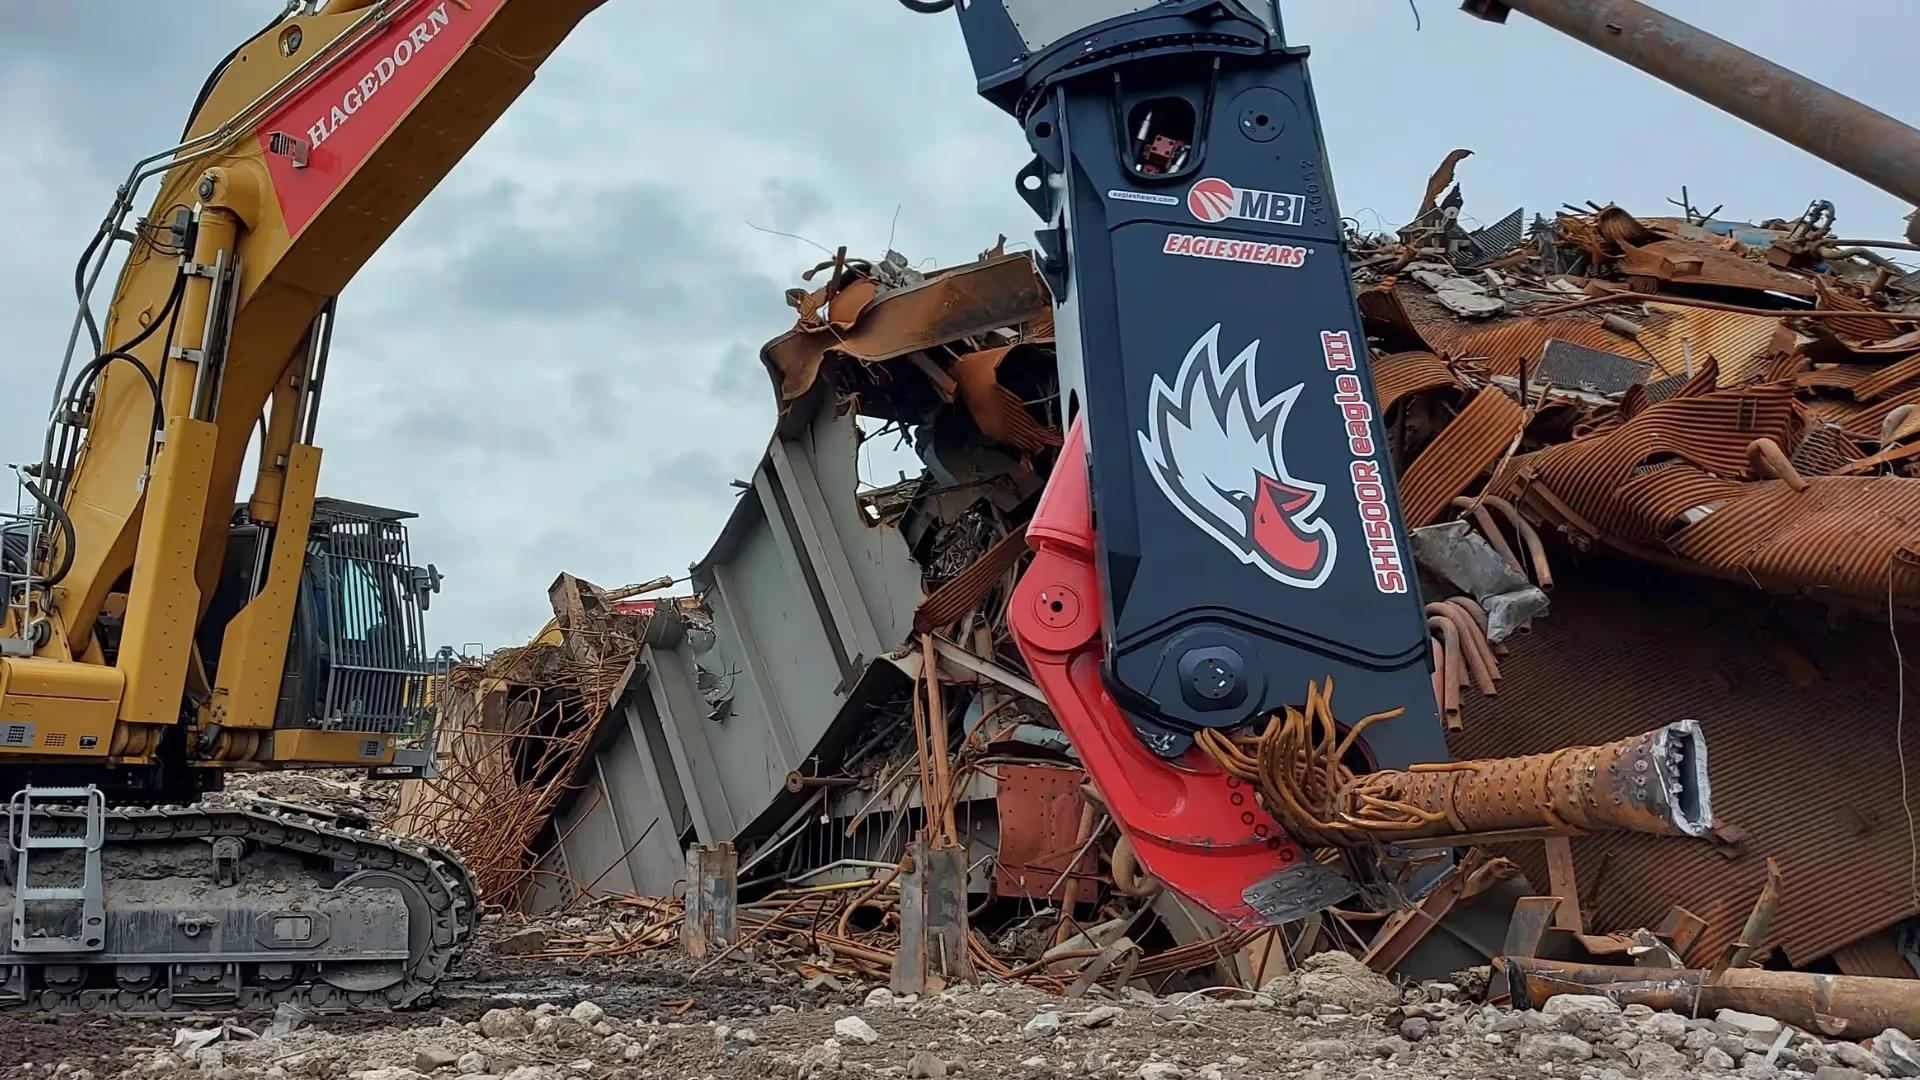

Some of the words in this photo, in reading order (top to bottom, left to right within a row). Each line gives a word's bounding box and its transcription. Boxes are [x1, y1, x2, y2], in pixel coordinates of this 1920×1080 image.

[306, 2, 450, 150] HAGEDORN
[1112, 191, 1176, 204] eagleshears.com
[1239, 190, 1304, 224] MBI
[1322, 332, 1355, 369] III
[1336, 375, 1372, 455] eagle
[1352, 461, 1405, 592] SH1500R
